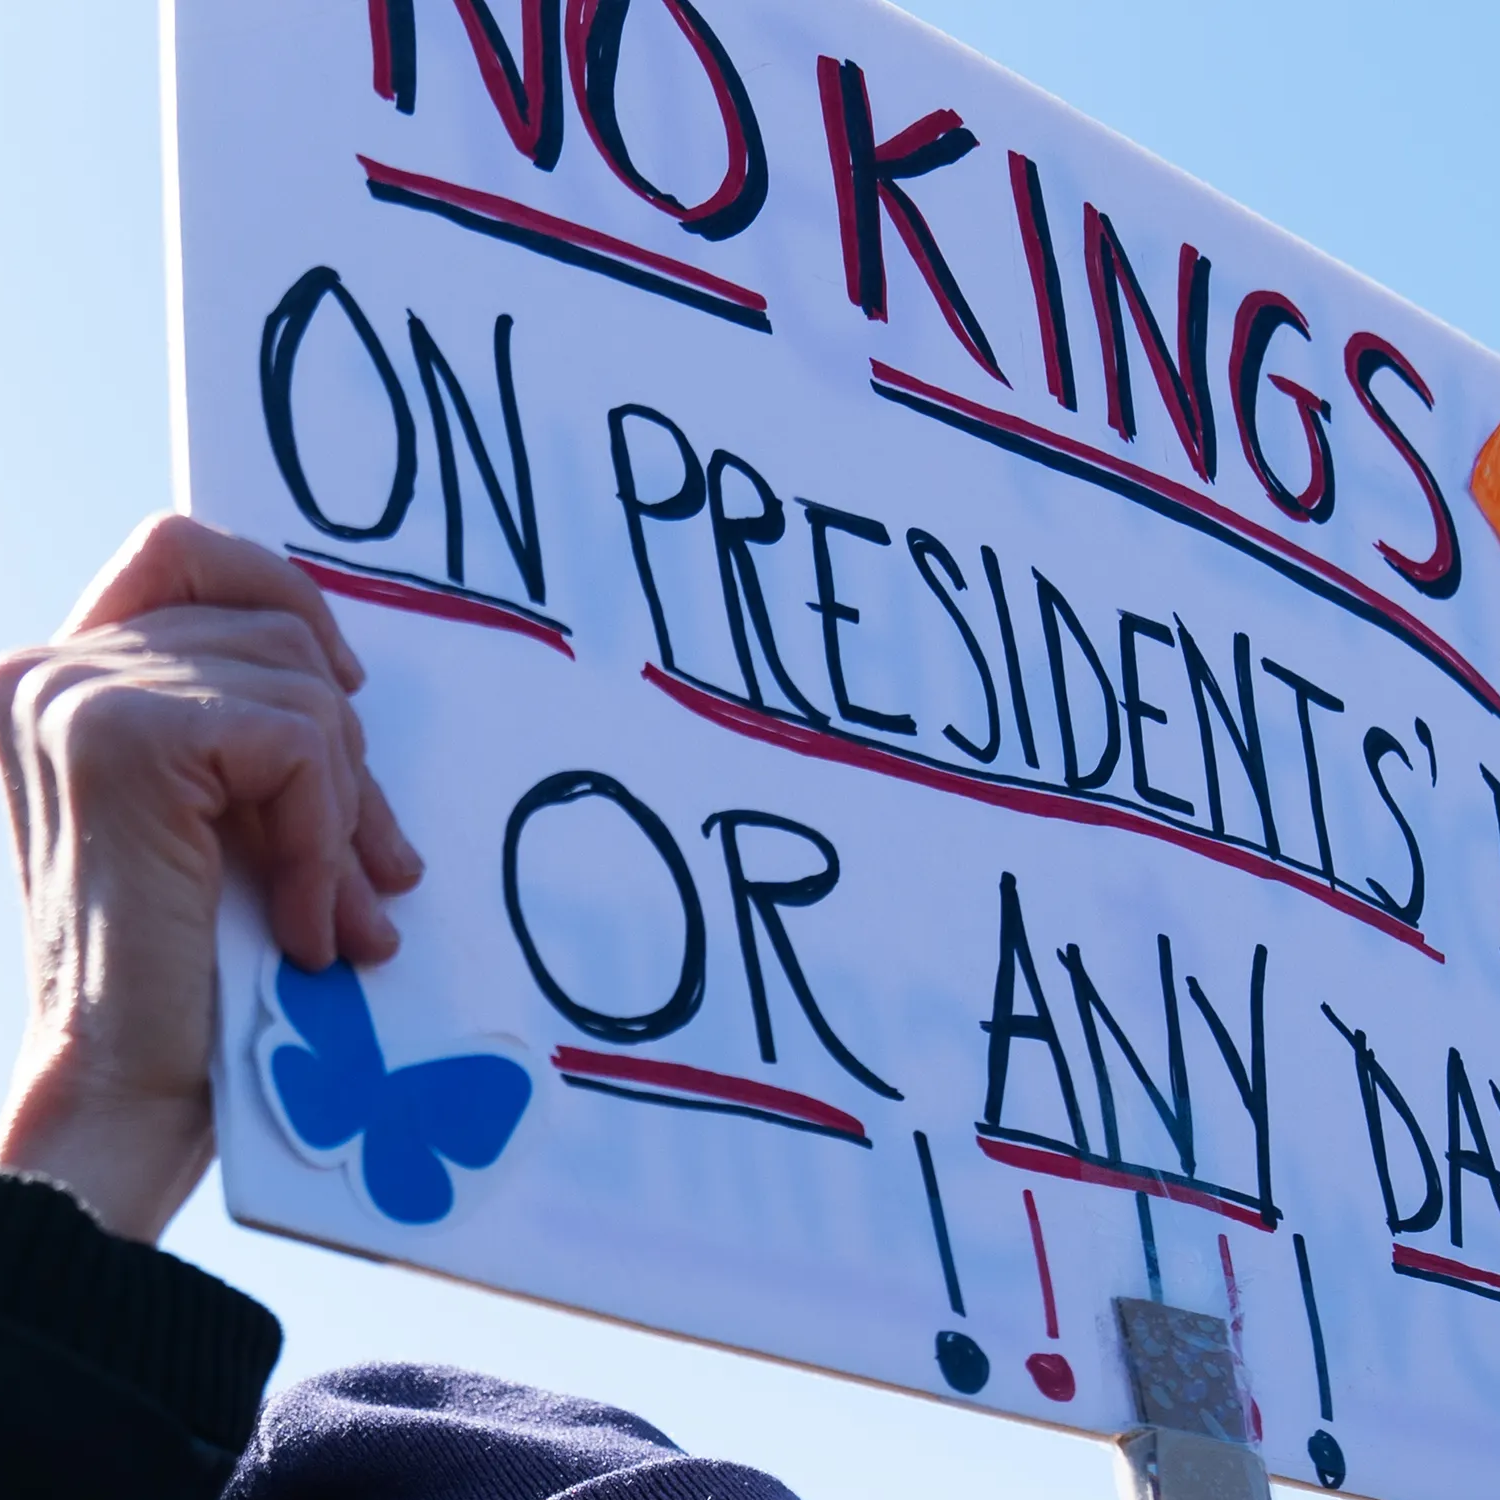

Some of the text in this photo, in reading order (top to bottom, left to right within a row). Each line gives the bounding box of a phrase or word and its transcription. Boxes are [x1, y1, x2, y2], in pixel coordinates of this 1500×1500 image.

[260, 265, 547, 604] ON
[608, 402, 1440, 928] PRESIDENTS'
[816, 56, 1465, 600] KINGS
[503, 770, 904, 1101] OR
[980, 872, 1278, 1228] ANY
